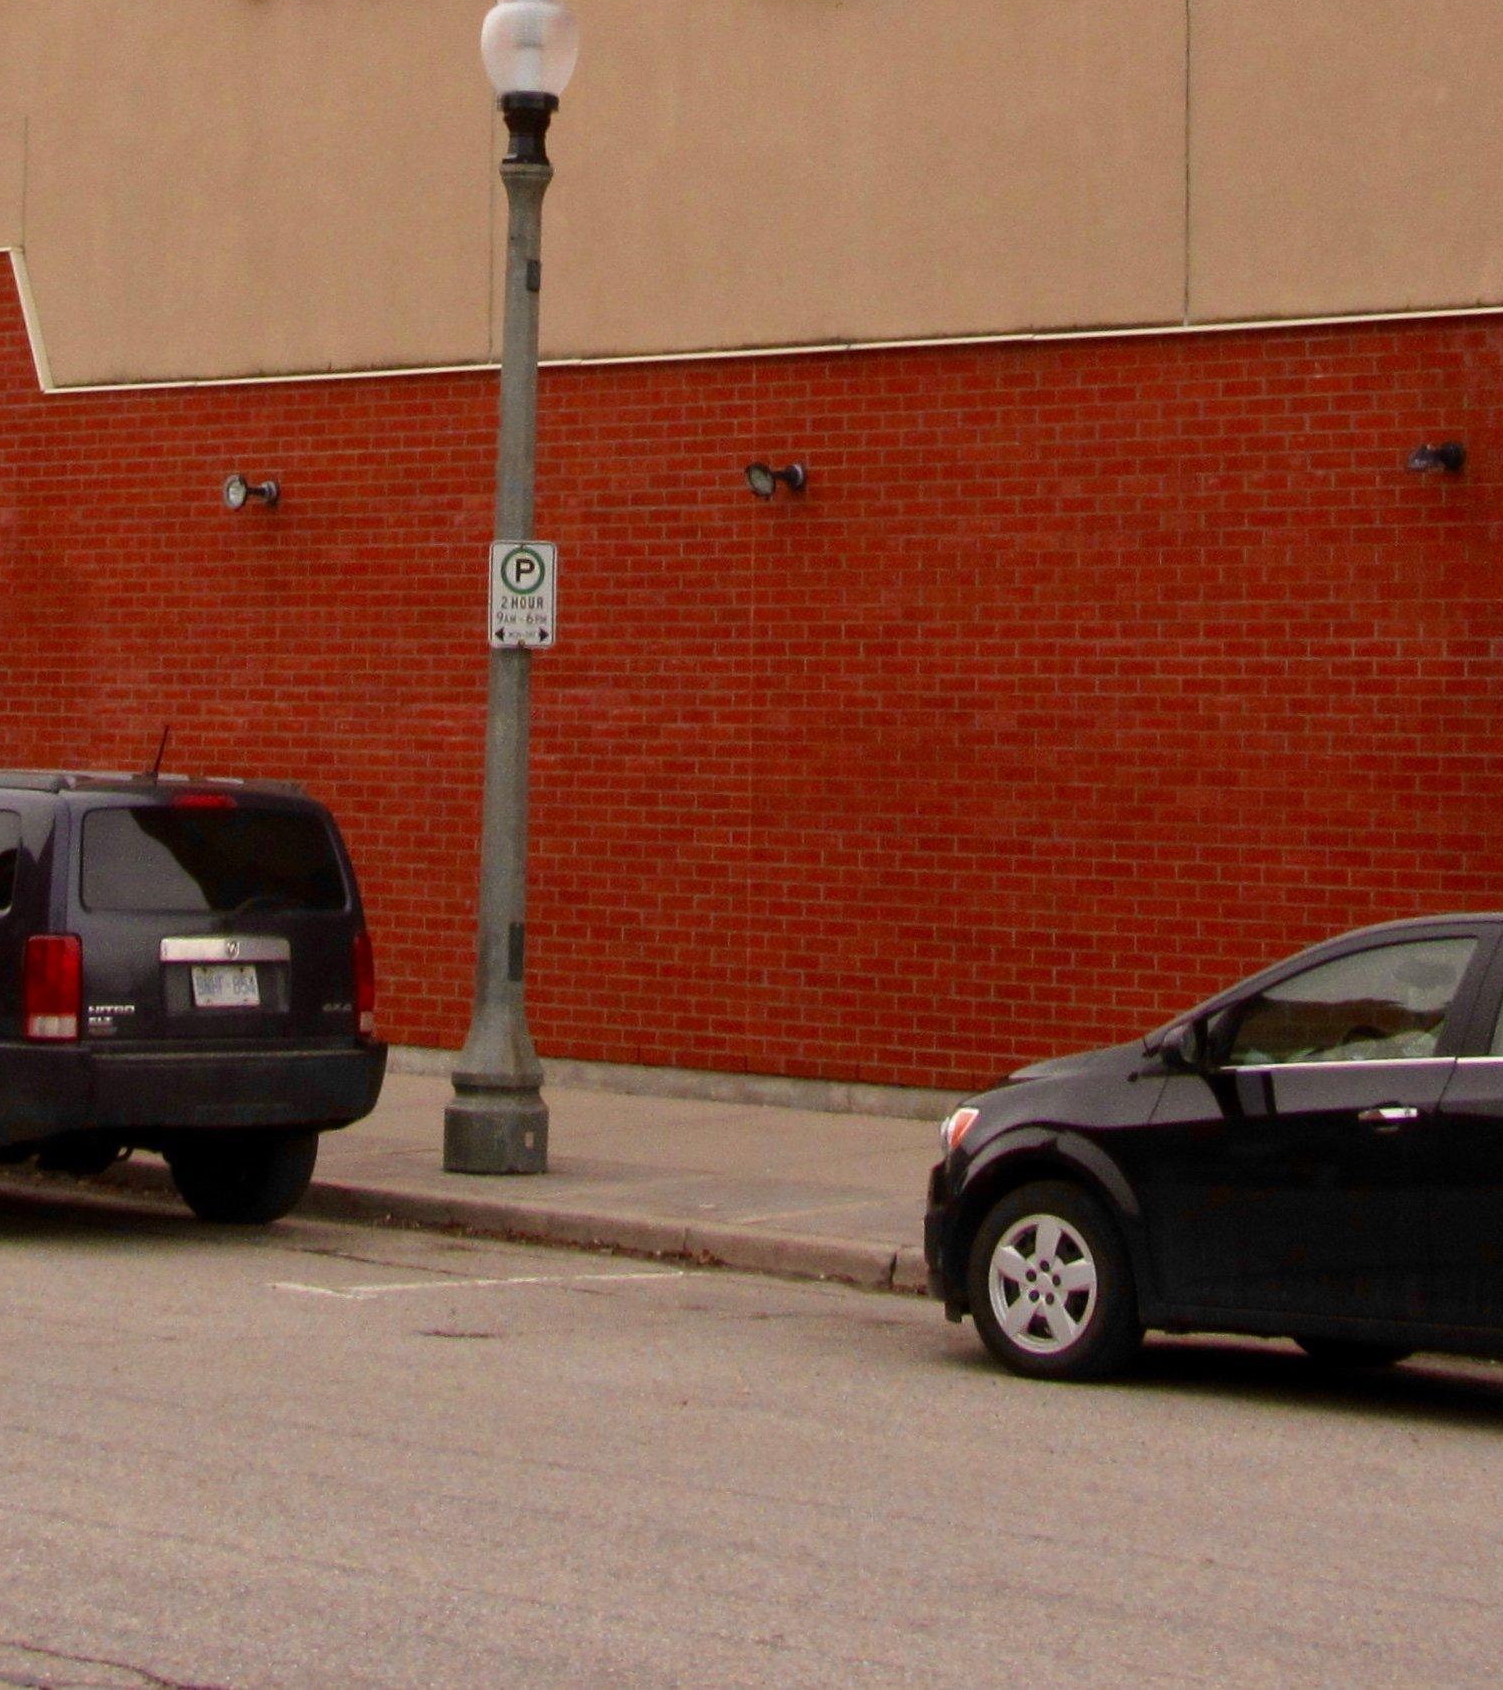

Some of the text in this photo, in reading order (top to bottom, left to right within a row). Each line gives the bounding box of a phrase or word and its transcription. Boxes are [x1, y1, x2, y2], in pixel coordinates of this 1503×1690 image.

[516, 558, 536, 583] P
[501, 595, 544, 610] 2 HOUR
